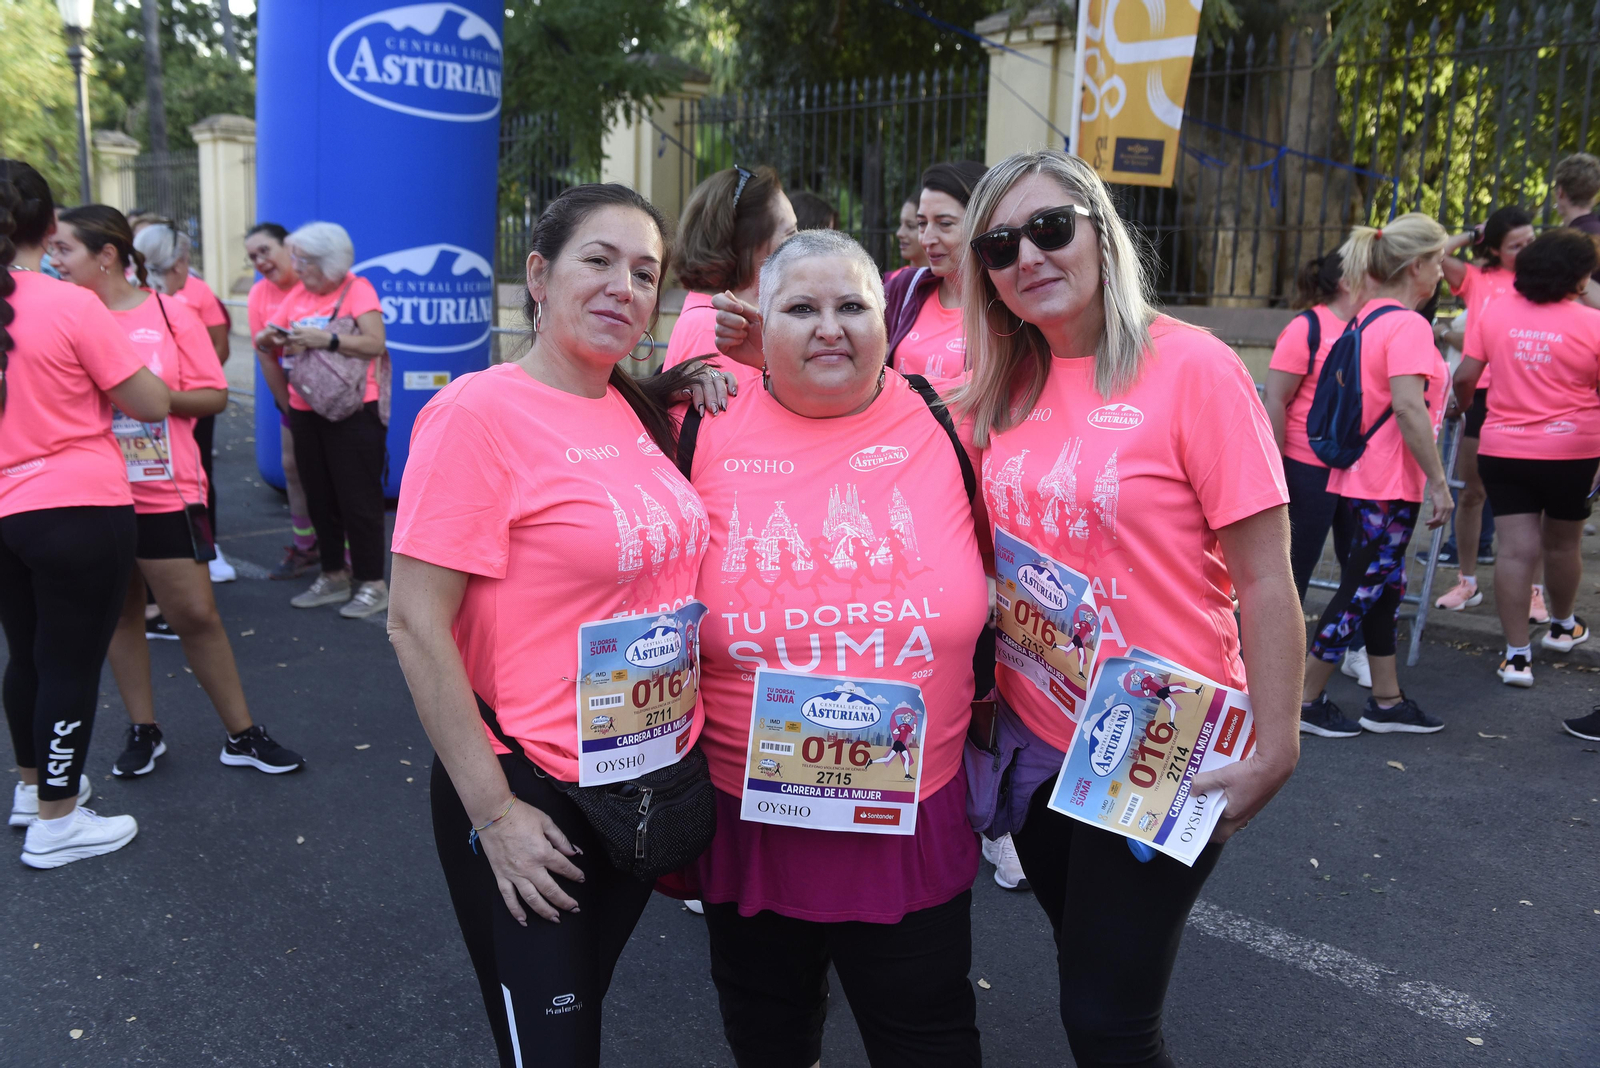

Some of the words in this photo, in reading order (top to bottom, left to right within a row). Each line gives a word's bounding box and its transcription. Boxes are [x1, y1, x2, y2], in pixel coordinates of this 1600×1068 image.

[386, 37, 458, 57] CENTRAL
[346, 36, 501, 98] ASTURIAN
[382, 280, 452, 293] CENTRAL
[1509, 328, 1562, 343] CARRERA
[1517, 340, 1532, 350] DE
[1536, 343, 1549, 352] LA
[1514, 351, 1551, 363] MUJER
[1091, 412, 1139, 425] ASTURIANA
[724, 458, 794, 474] OYSHO
[854, 451, 904, 467] ASTURIANA
[1020, 569, 1063, 608] ASTURIANA
[722, 611, 767, 635] TU
[784, 597, 941, 630] DORSAL
[1014, 599, 1057, 647] 016
[590, 644, 618, 656] SUMA
[728, 625, 935, 673] SUMA
[1021, 634, 1045, 657] 2712
[996, 645, 1025, 667] YSHO
[1001, 633, 1027, 655] CARRERA
[1028, 651, 1037, 660] DE
[1037, 657, 1046, 667] LA
[1045, 663, 1065, 682] MUJER
[911, 668, 934, 680] 2022
[632, 671, 683, 709] 016
[766, 693, 795, 704] SUMA
[646, 707, 672, 726] 2711
[806, 702, 875, 723] ASTURIANA
[616, 730, 651, 746] CARRERA
[653, 728, 662, 737] DE
[664, 724, 672, 733] LA
[1225, 714, 1239, 742] Santander
[1095, 709, 1130, 773] ASTURIANA
[802, 736, 872, 767] 016
[1129, 720, 1173, 788] 016
[596, 753, 645, 773] OYSHO
[1166, 746, 1189, 783] 2714
[1169, 780, 1192, 818] CARRERA
[1186, 765, 1197, 779] DE
[1192, 753, 1203, 765] LA
[1199, 721, 1215, 752] MUJER
[816, 771, 852, 785] 2715
[780, 783, 822, 796] CARRERA
[824, 787, 836, 797] DE
[838, 789, 850, 798] LA
[851, 789, 882, 800] MUJER
[1076, 780, 1092, 807] SUMA
[757, 801, 811, 818] OYSHO
[1101, 799, 1109, 810] IMD
[867, 811, 895, 820] Santander
[1180, 793, 1208, 843] OYSHO
[546, 1001, 583, 1015] Kalenji
